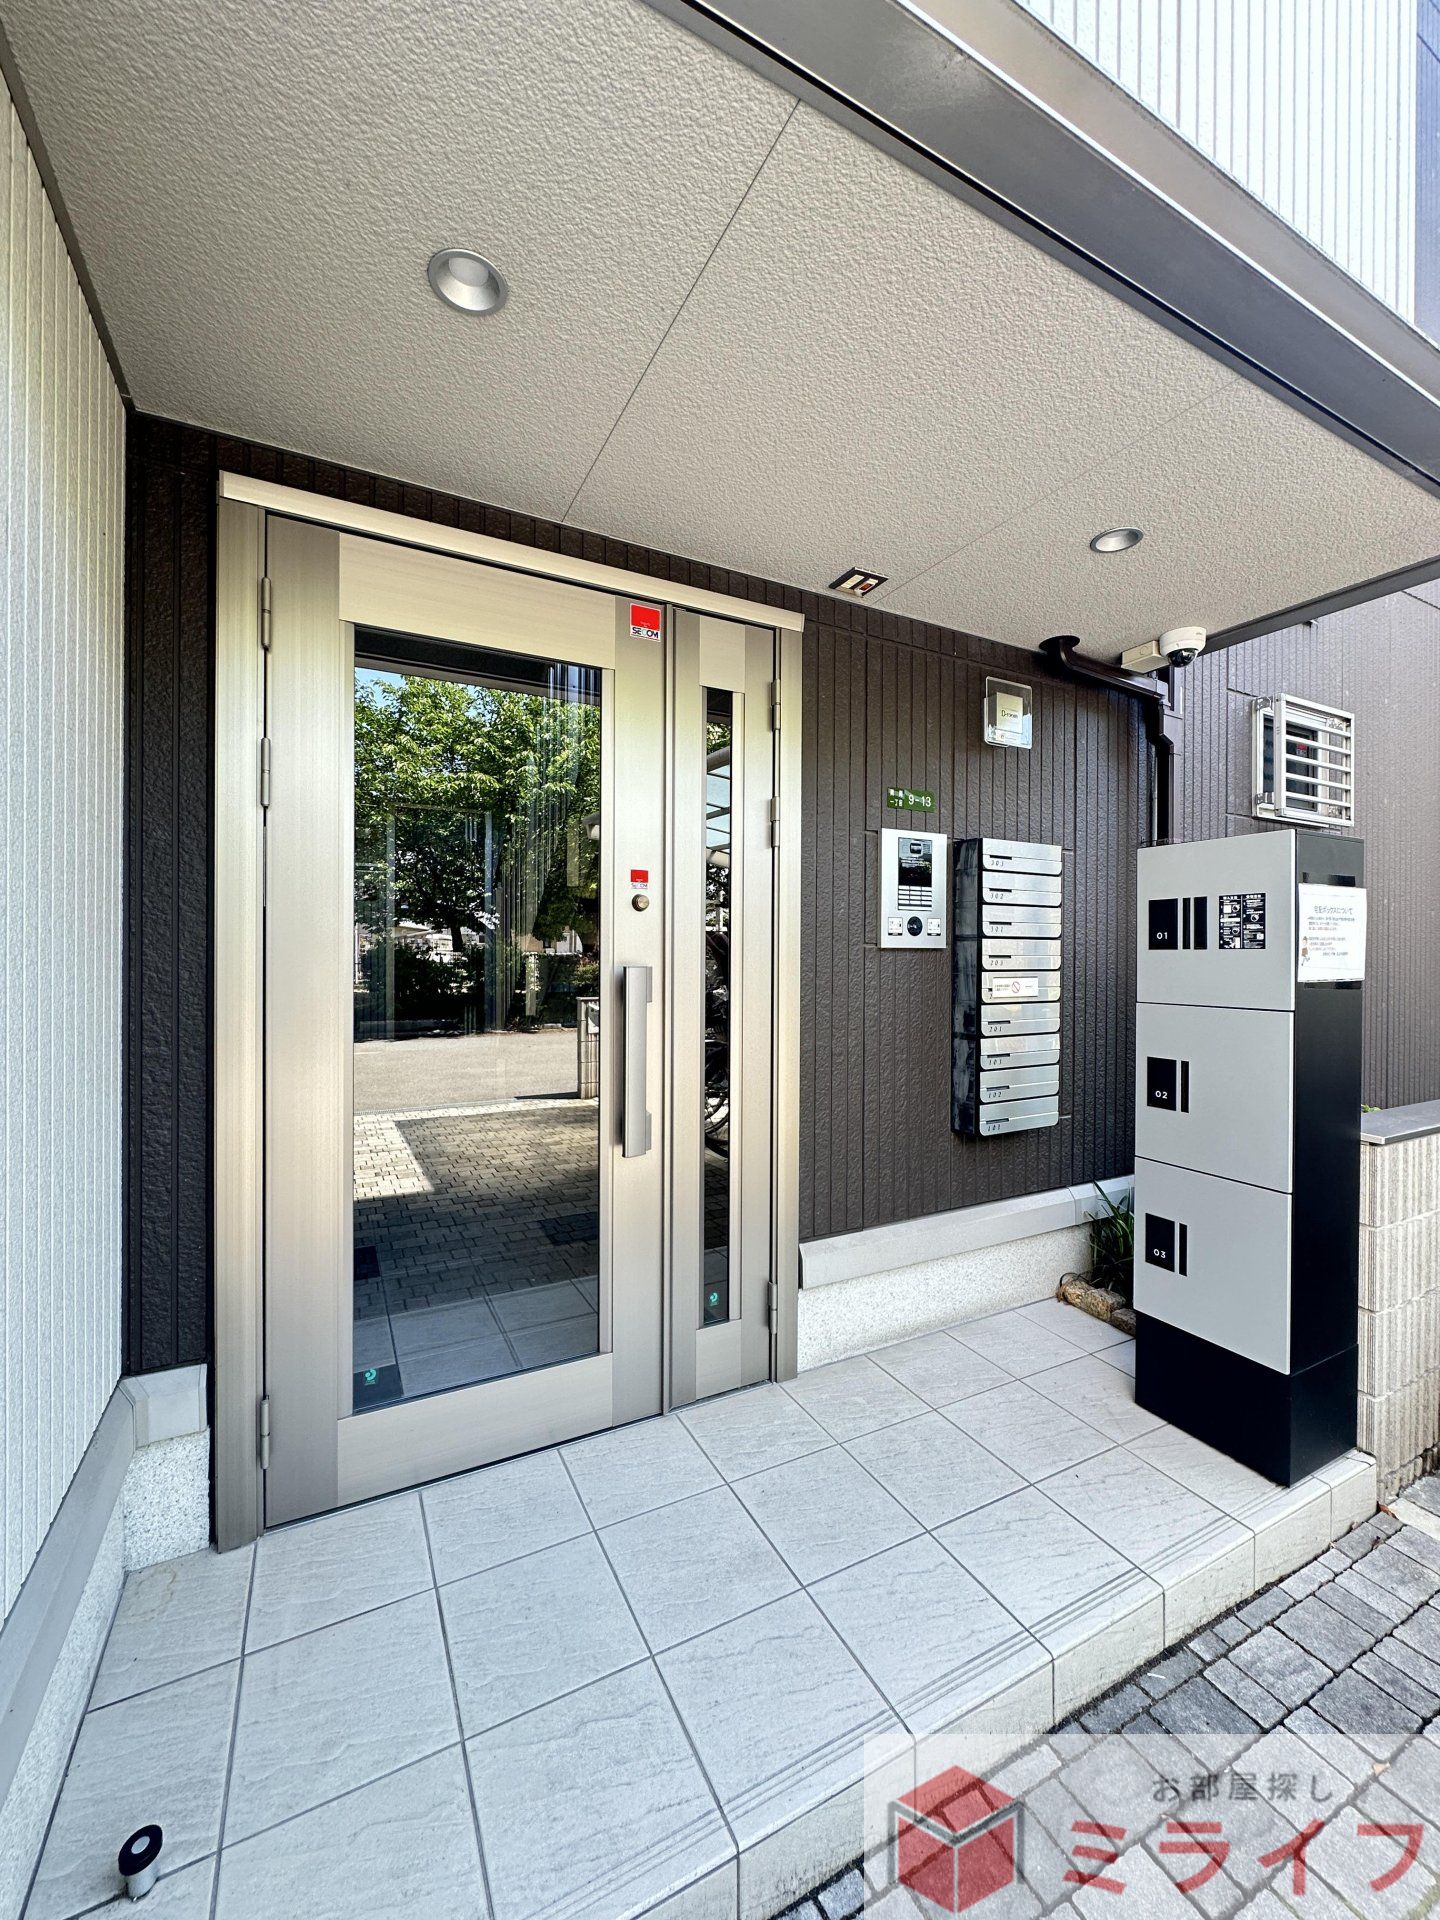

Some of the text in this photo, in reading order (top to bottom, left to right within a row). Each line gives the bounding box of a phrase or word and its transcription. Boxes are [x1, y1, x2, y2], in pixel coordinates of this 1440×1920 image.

[632, 626, 659, 639] SECOM
[908, 794, 932, 807] 9-13
[990, 892, 1004, 900] 302
[1156, 931, 1168, 940] 01
[988, 1091, 1002, 1099] 102
[1155, 1090, 1168, 1099] 02
[1153, 1248, 1166, 1259] 03
